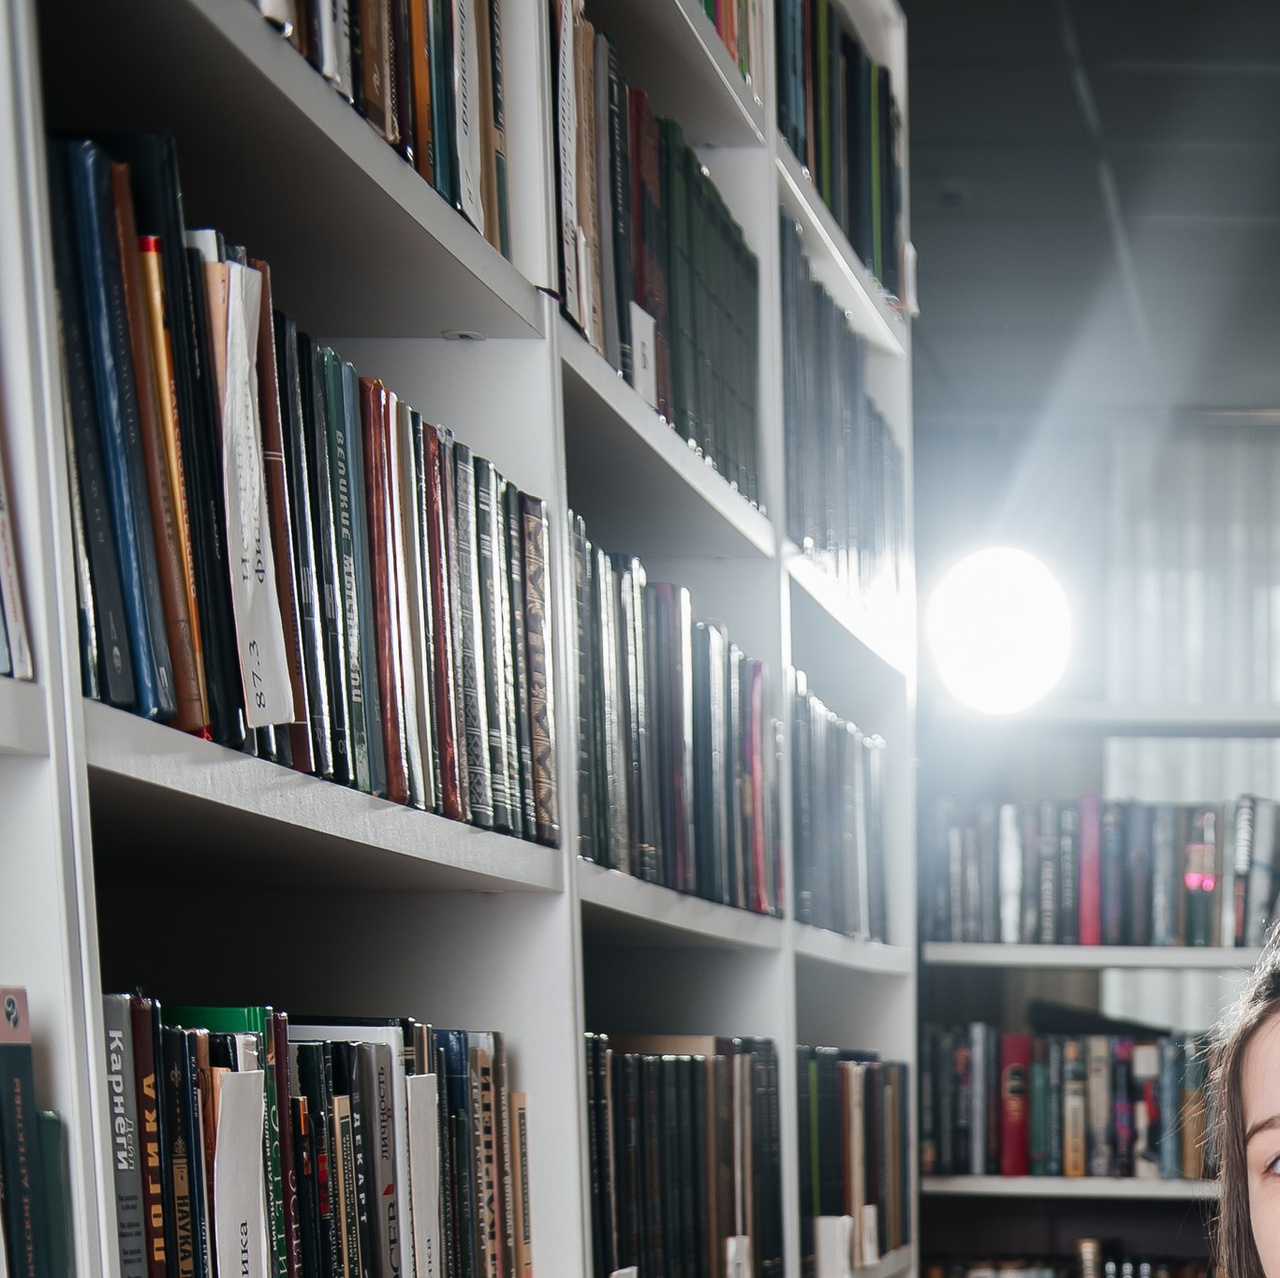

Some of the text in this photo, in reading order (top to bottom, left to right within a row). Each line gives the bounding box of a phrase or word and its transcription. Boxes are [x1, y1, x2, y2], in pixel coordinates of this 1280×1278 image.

[336, 430, 351, 540] ВЕЛИКИЕ
[249, 640, 266, 708] 87.3
[106, 1029, 129, 1171] Карнеги
[124, 1117, 136, 1171] Дейл
[376, 1065, 389, 1161] ЛИЧНОСТЬ
[142, 1072, 169, 1262] ЛОГИКА
[353, 1111, 367, 1224] ДЕКАРТ
[176, 1194, 196, 1272] НАУКА
